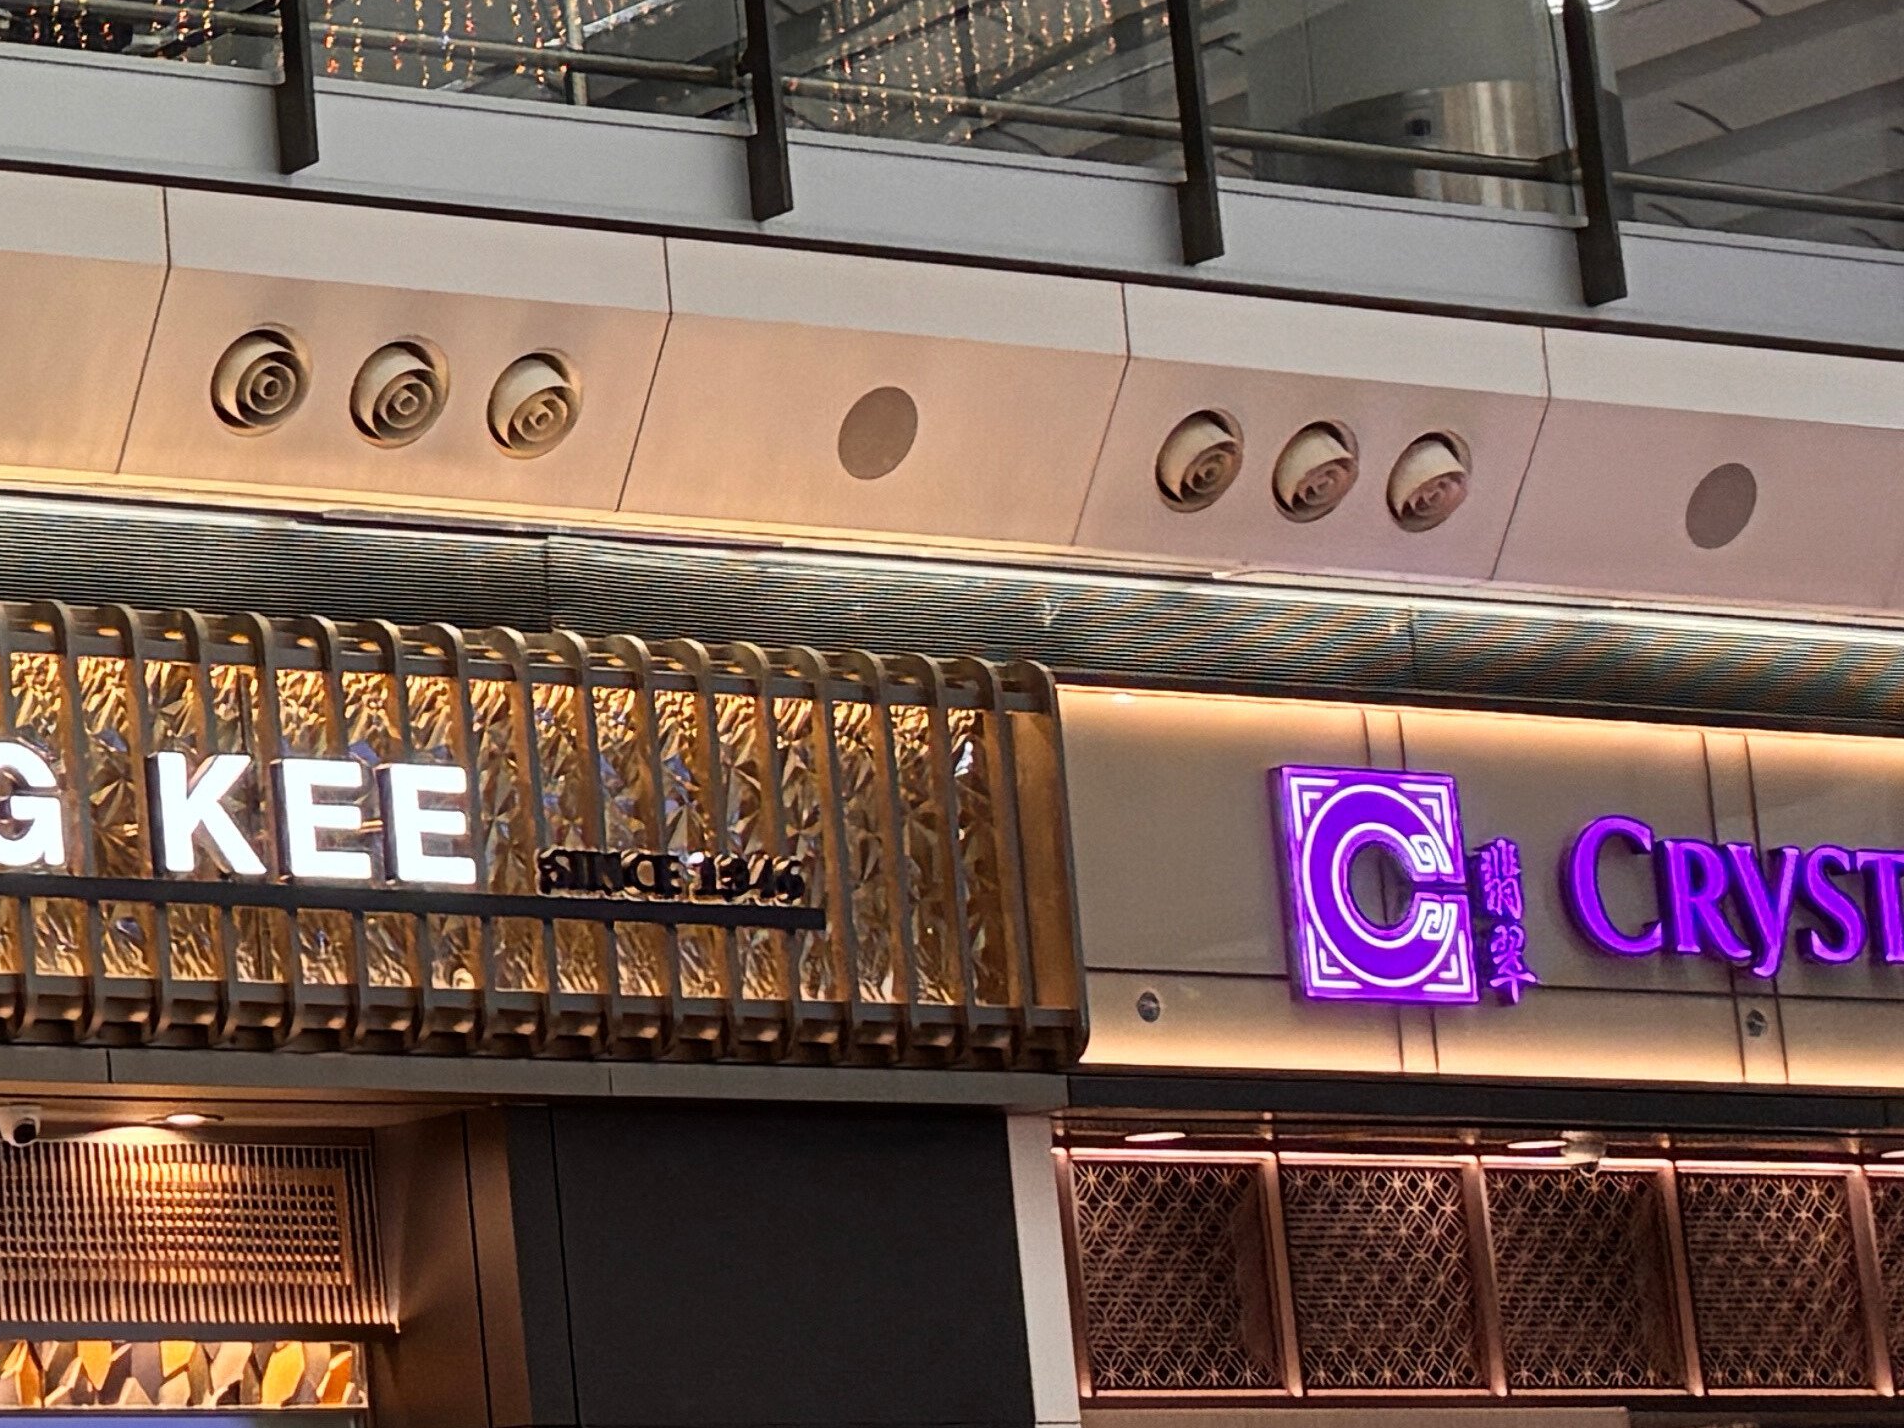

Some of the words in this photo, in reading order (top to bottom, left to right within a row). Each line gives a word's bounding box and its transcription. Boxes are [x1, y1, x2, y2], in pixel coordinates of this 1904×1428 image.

[150, 750, 478, 884] KEE
[538, 848, 681, 899] SINCE
[1481, 838, 1537, 1003] 翡翠
